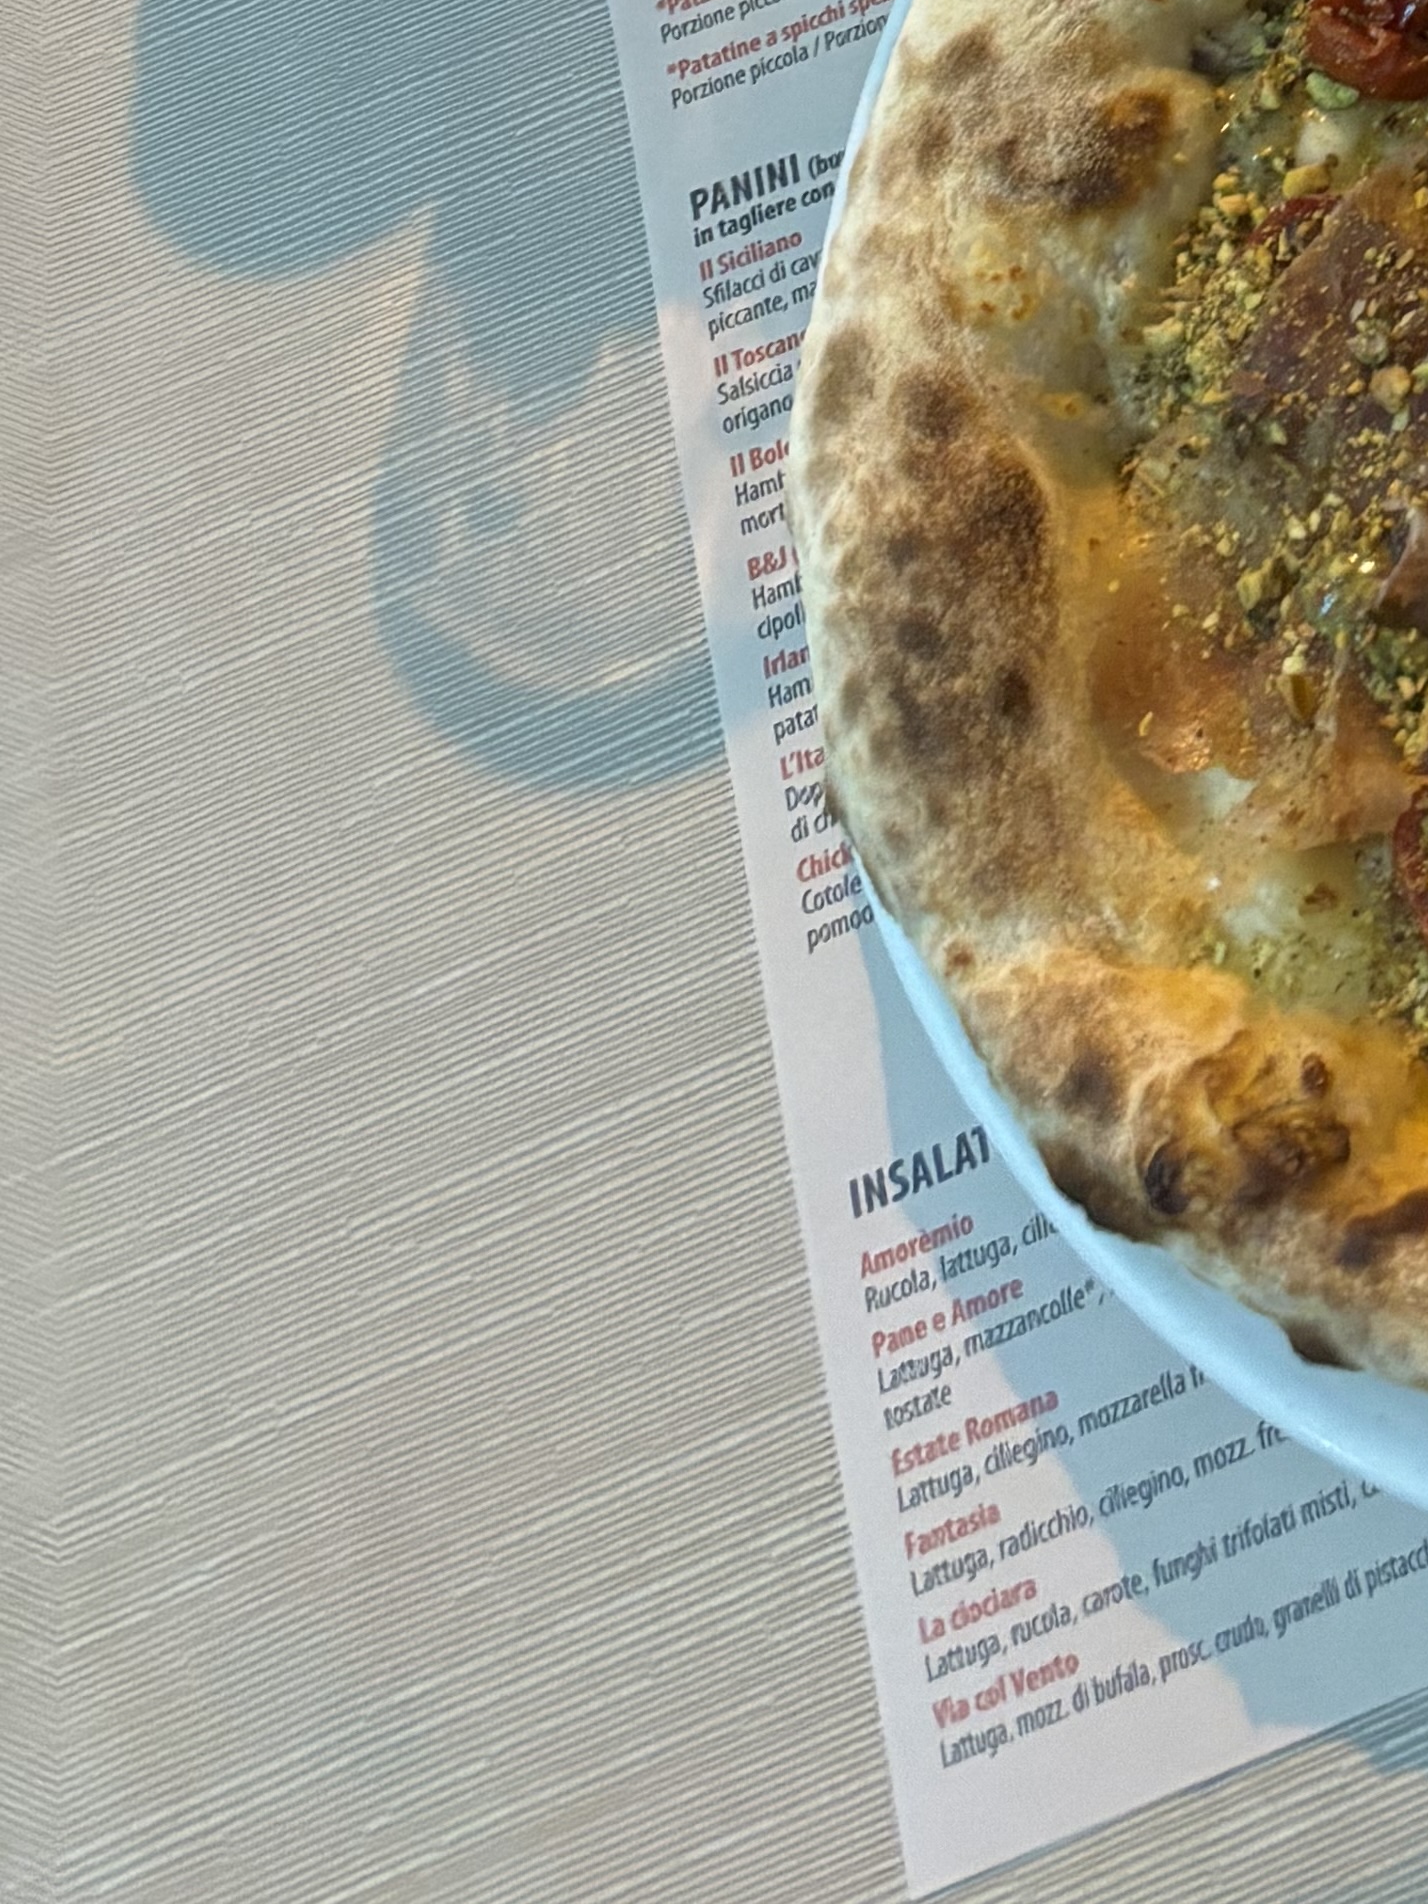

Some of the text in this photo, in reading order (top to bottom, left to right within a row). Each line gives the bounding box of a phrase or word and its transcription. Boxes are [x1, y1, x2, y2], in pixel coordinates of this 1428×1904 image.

[689, 152, 801, 222] PANINI
[698, 230, 803, 282] Il Siciliano
[871, 1278, 1024, 1359] Pane e Amore
[890, 1389, 1060, 1478] Estate Romana
[932, 1652, 1081, 1729] Via col Vento
